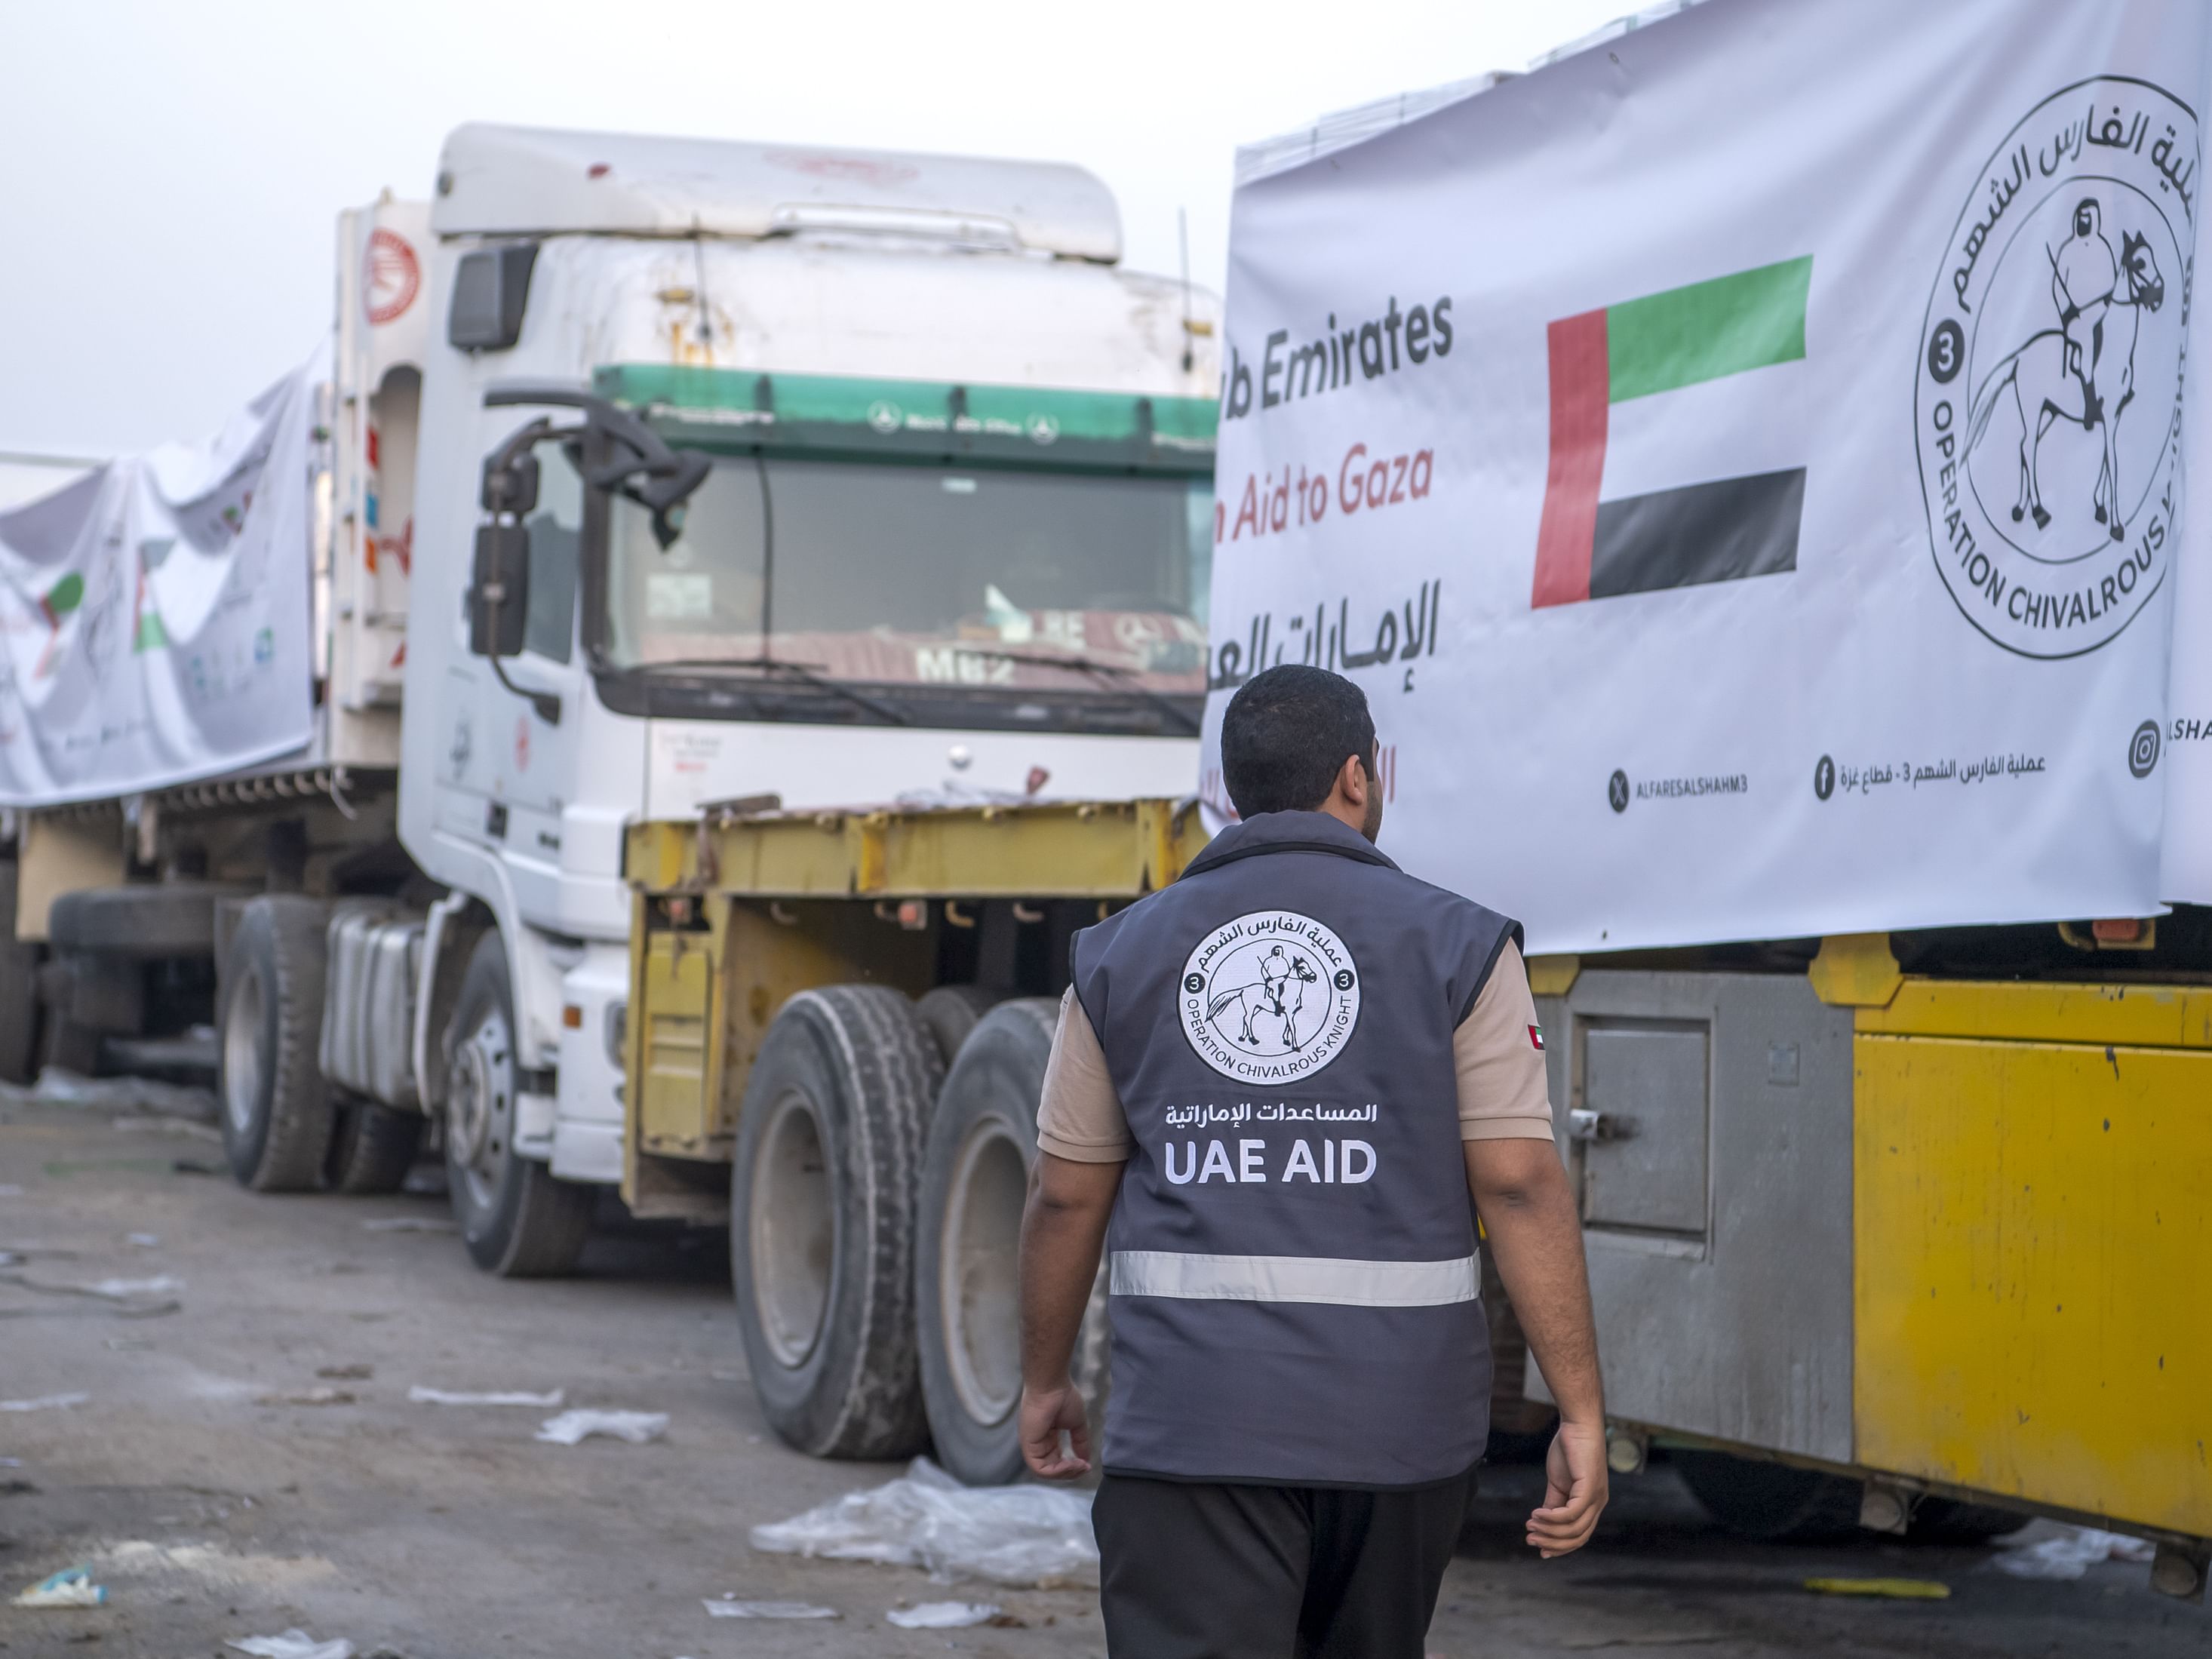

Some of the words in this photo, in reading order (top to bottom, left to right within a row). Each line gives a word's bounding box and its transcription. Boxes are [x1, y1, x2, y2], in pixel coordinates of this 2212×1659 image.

[2039, 104, 2150, 177] الفارس
[1953, 143, 2031, 314] الشهم
[1261, 295, 1453, 410] Emirates
[1232, 462, 1290, 542] Aid
[1297, 462, 1328, 527] to
[1339, 441, 1434, 515] Gaza
[1933, 400, 2007, 608] OPERATION
[2008, 515, 2165, 628] CHIVALROUS
[1841, 764, 1859, 793] غزة
[1862, 764, 1892, 795] قطاع
[1914, 758, 1956, 790] الشهم
[1960, 755, 2005, 784] الفارس
[2008, 753, 2045, 779] عملية
[1636, 773, 1748, 800] ALFARESALSHAHM3
[1247, 916, 1307, 935] الفارس
[1197, 923, 1243, 973] الشهم
[1307, 926, 1342, 967] عملية
[1187, 998, 1236, 1069] OPERATION
[1237, 1045, 1327, 1078] CHIVALROUS
[1324, 995, 1352, 1049] KNIGHT
[1165, 1103, 1251, 1129] الإماراتية
[1255, 1103, 1378, 1123] المساعدات
[1165, 1138, 1267, 1184] UAE
[1281, 1138, 1378, 1184] AID
